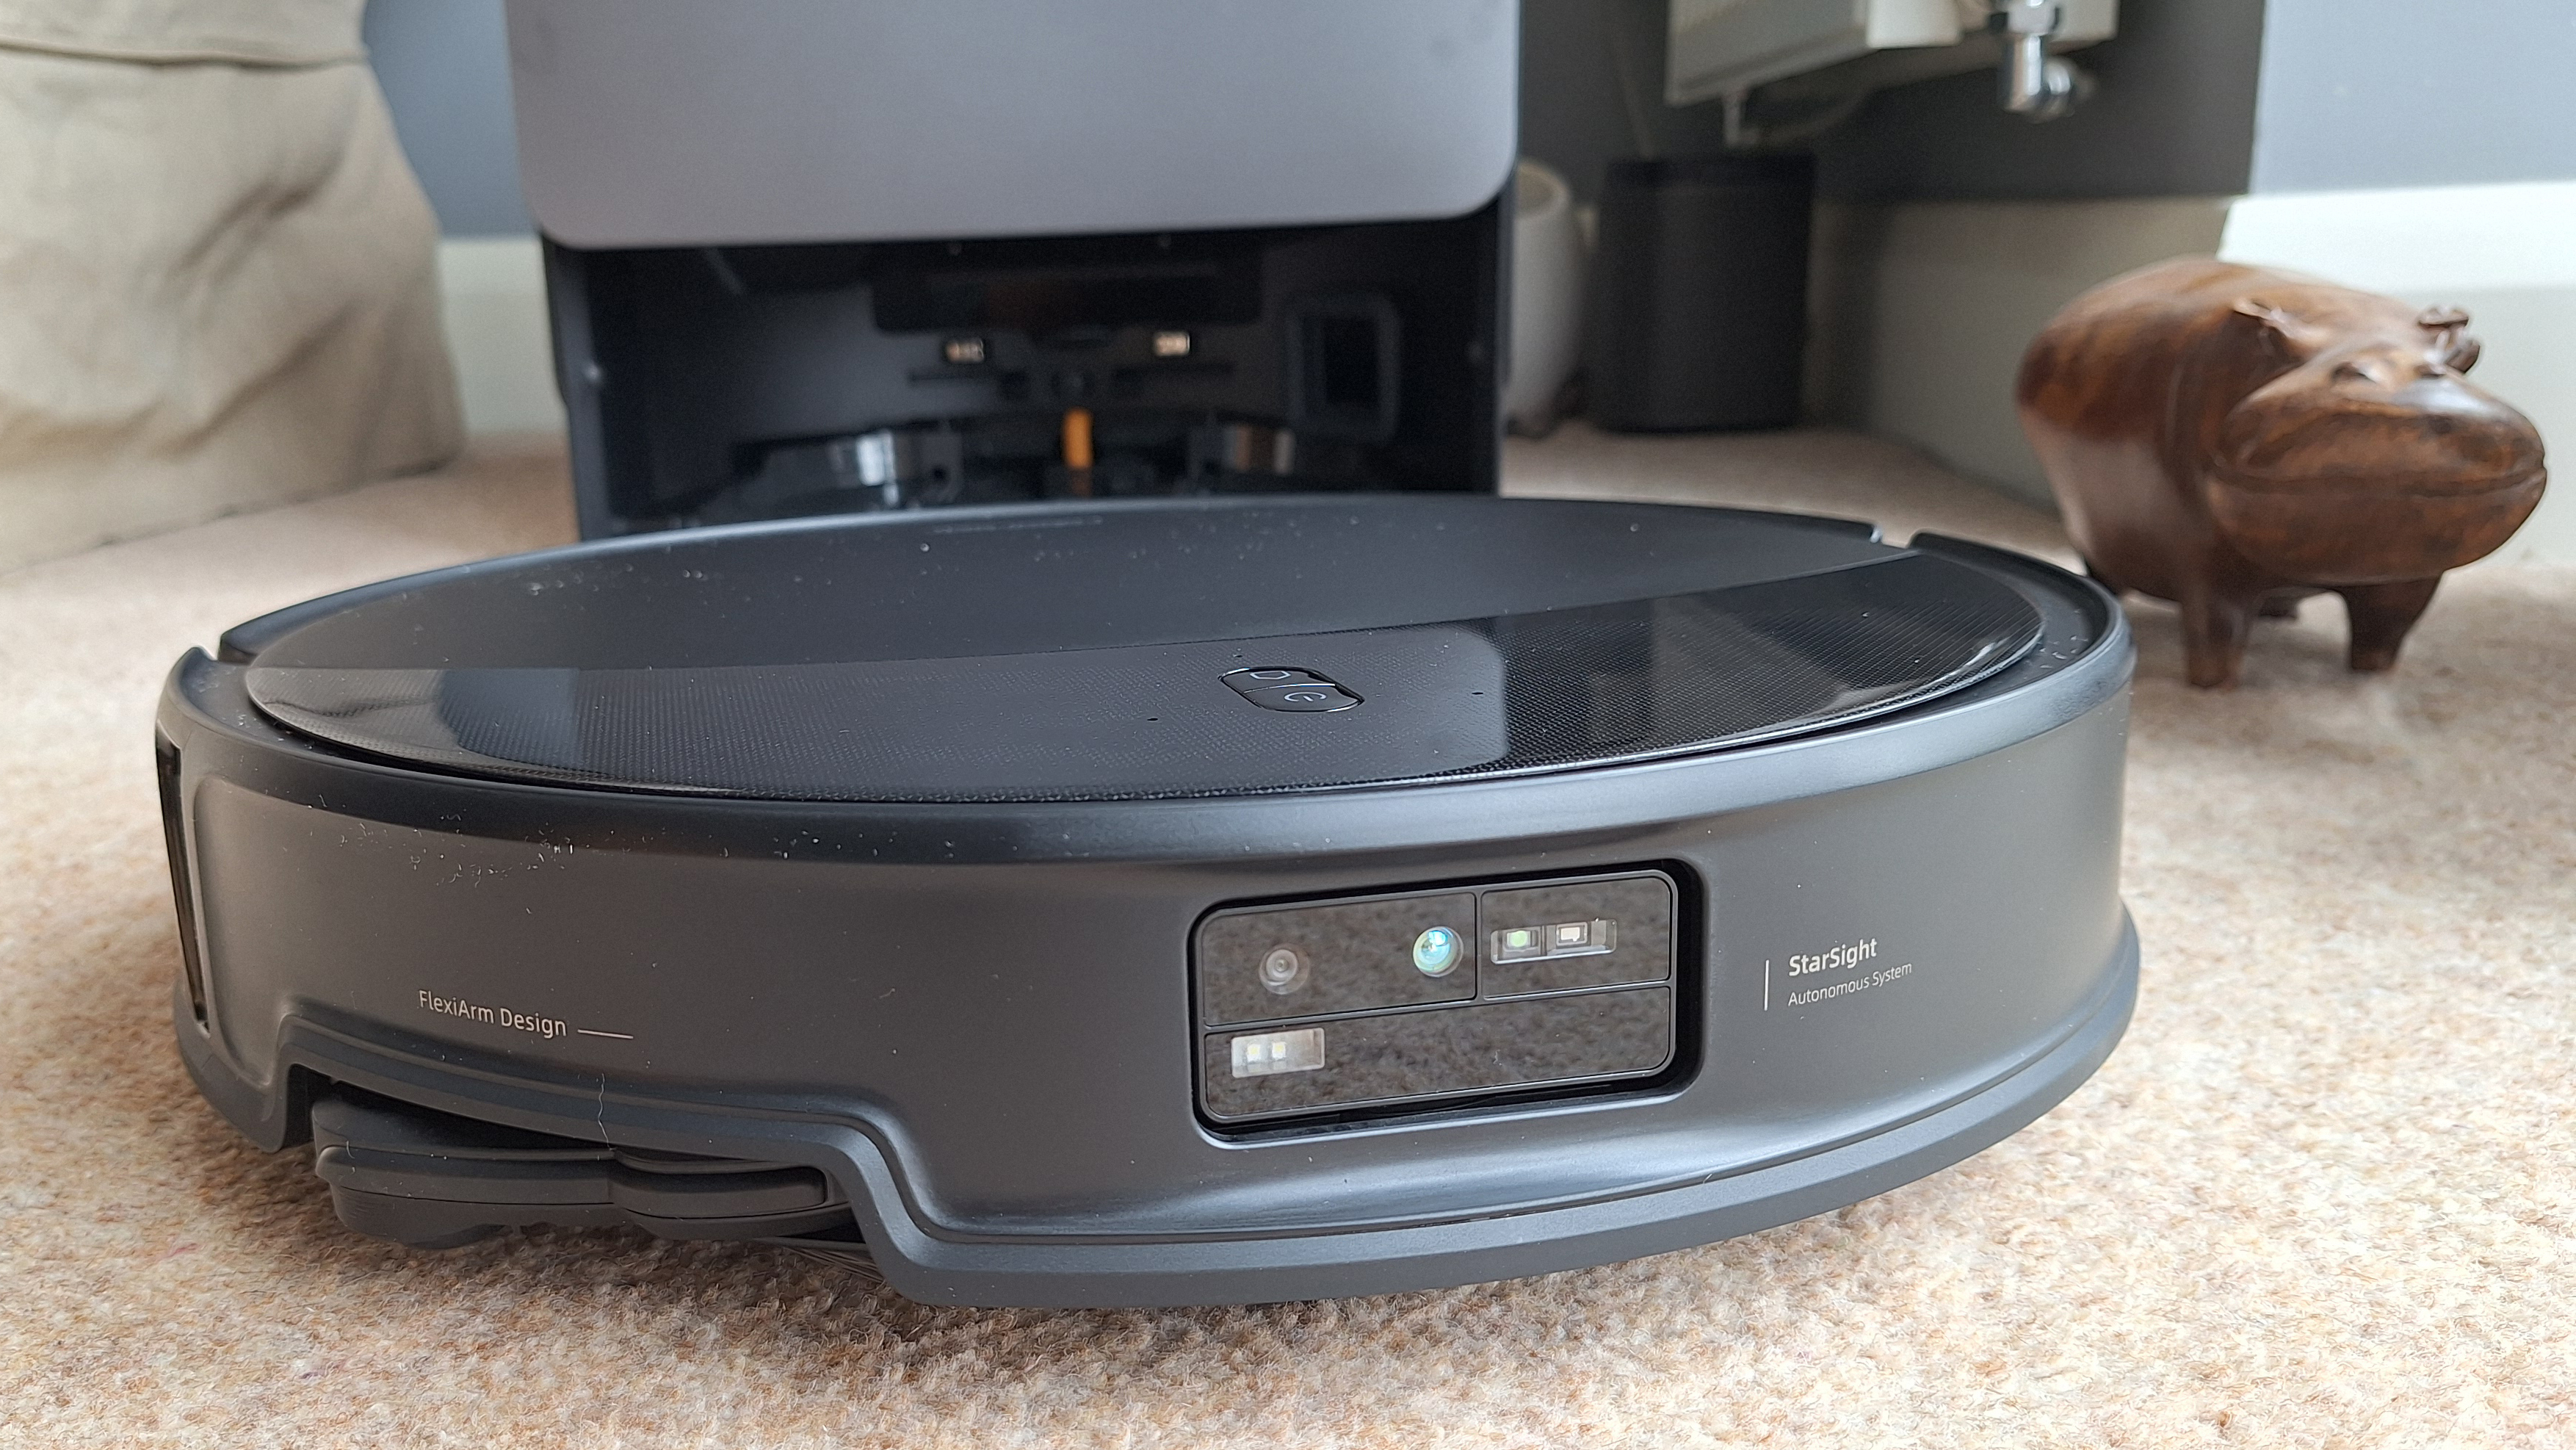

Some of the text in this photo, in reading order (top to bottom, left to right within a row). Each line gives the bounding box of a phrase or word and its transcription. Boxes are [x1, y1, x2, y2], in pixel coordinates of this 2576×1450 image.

[1788, 938, 1877, 976] StarSight
[1788, 963, 1912, 1006] Autonomous System
[419, 990, 567, 1039] FlexiArm Design
